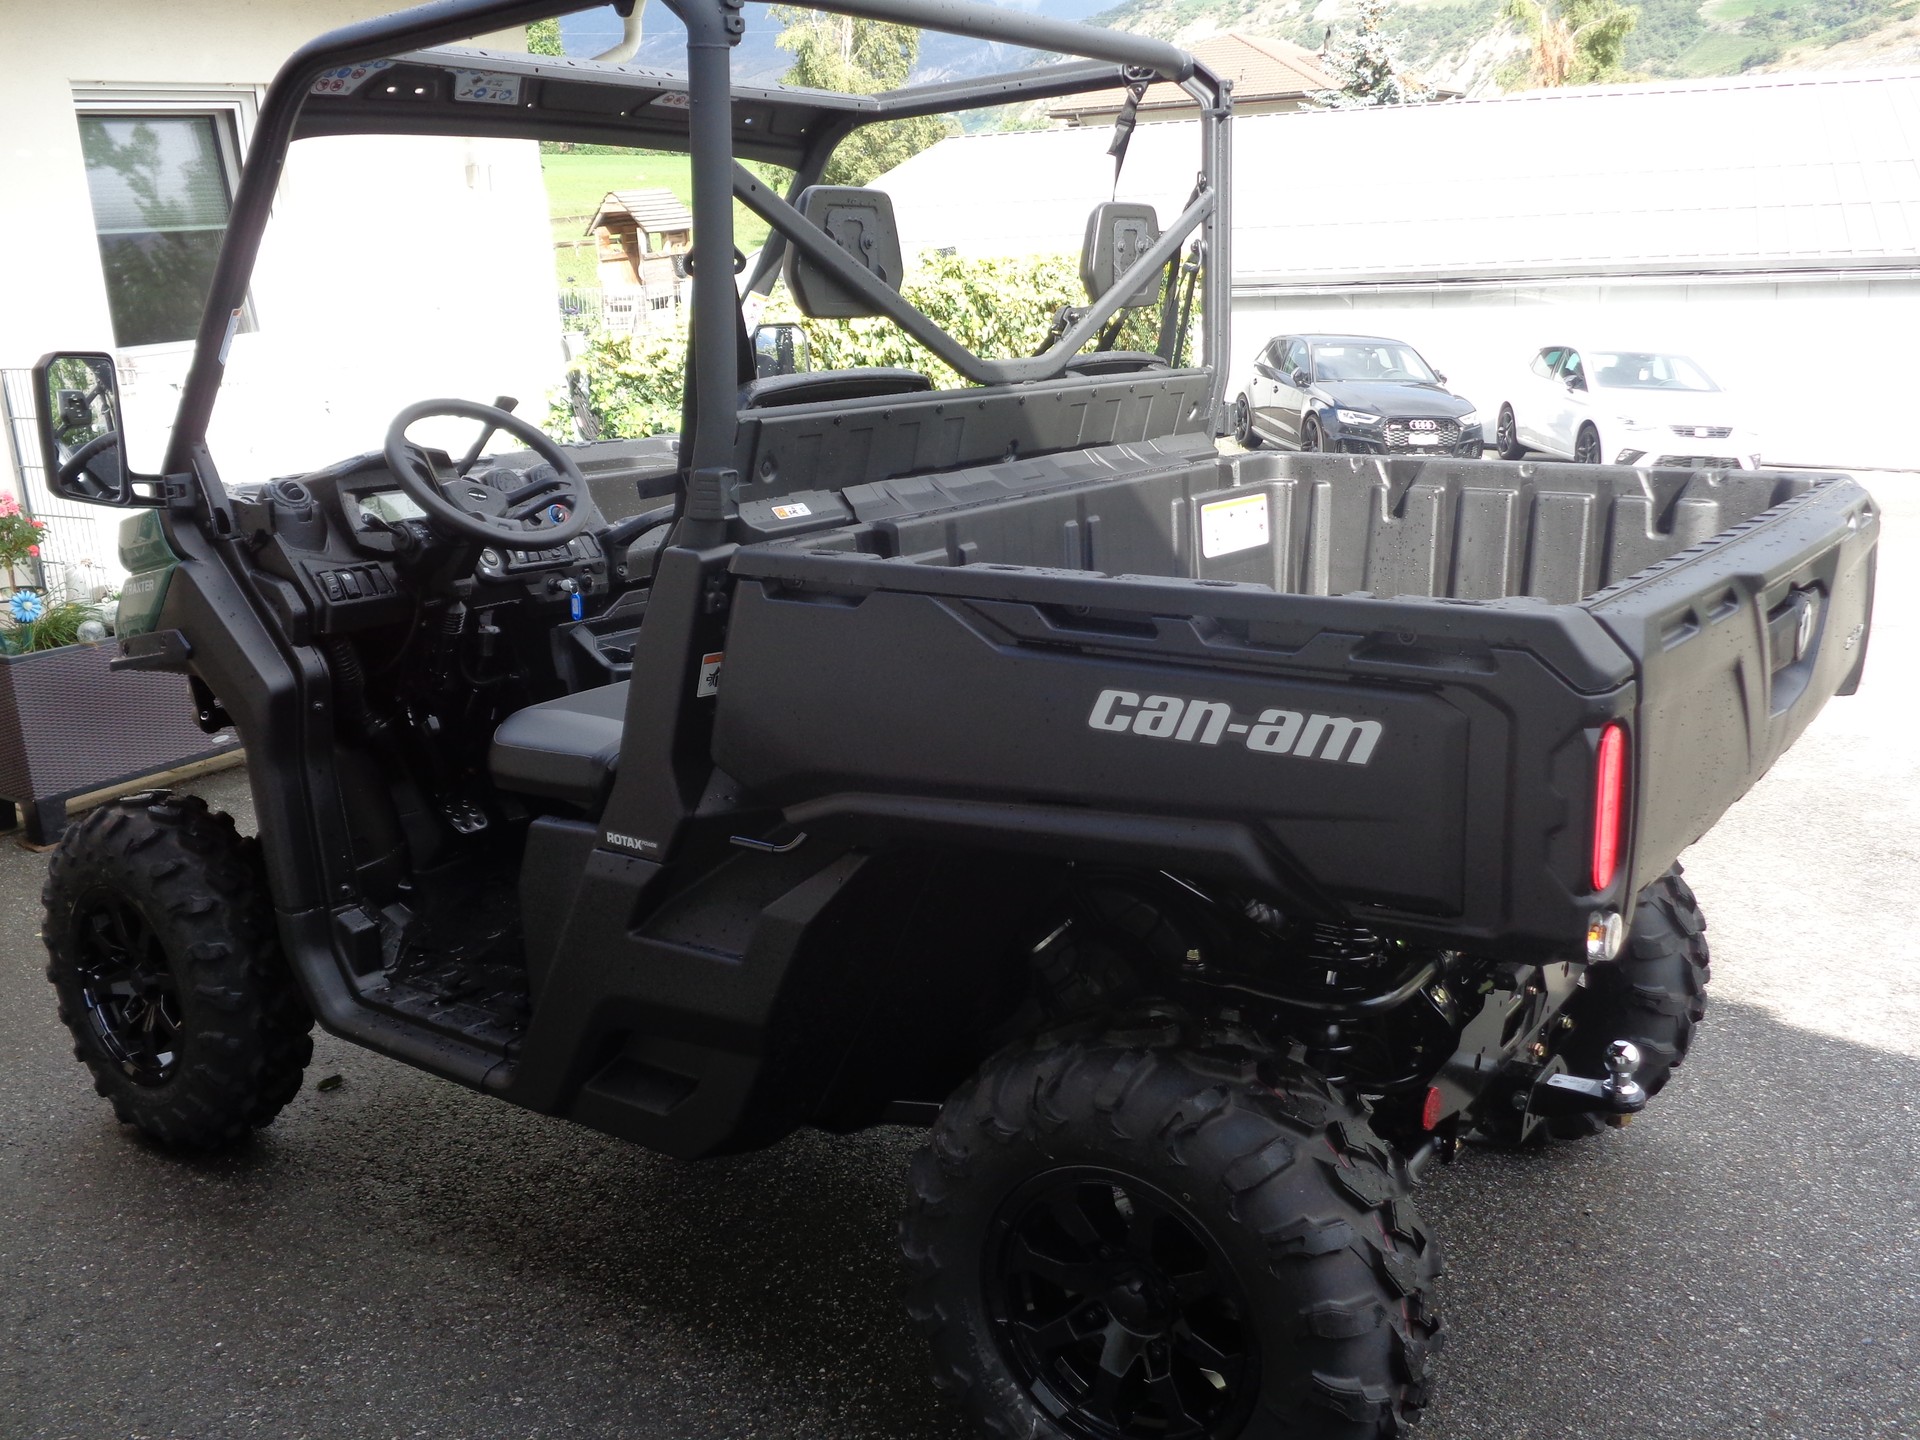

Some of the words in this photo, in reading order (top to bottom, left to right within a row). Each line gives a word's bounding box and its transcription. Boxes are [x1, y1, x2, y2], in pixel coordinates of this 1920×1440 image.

[124, 580, 154, 595] TRAXTER
[1088, 689, 1383, 765] can-am
[606, 831, 642, 850] ROTAX
